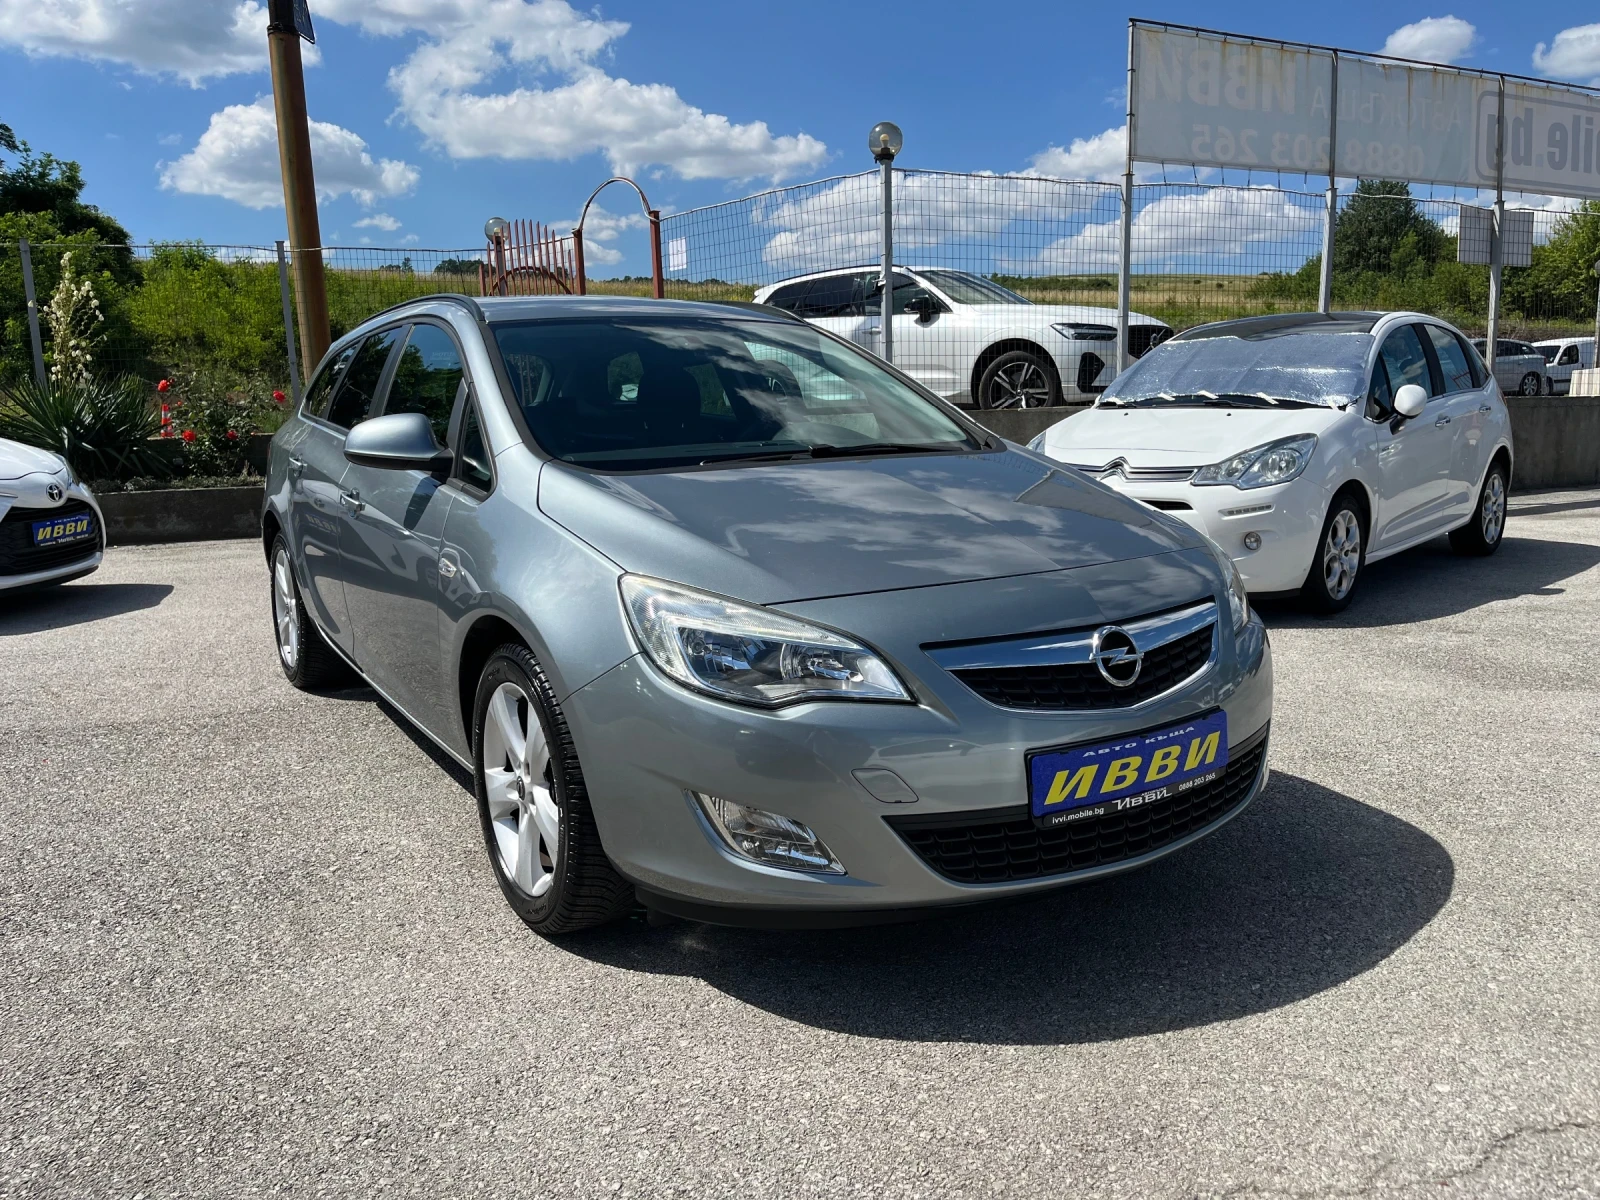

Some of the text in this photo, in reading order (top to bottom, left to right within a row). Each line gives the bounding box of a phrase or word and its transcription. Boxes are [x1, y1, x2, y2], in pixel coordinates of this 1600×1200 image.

[37, 519, 88, 541] ИВВИ
[1082, 726, 1195, 758] АВТО КЪЩА
[1043, 730, 1221, 806] ИВВИ
[1194, 776, 1205, 786] 203
[1205, 772, 1216, 781] 265
[1052, 807, 1105, 824] ivvi.mobile.bg
